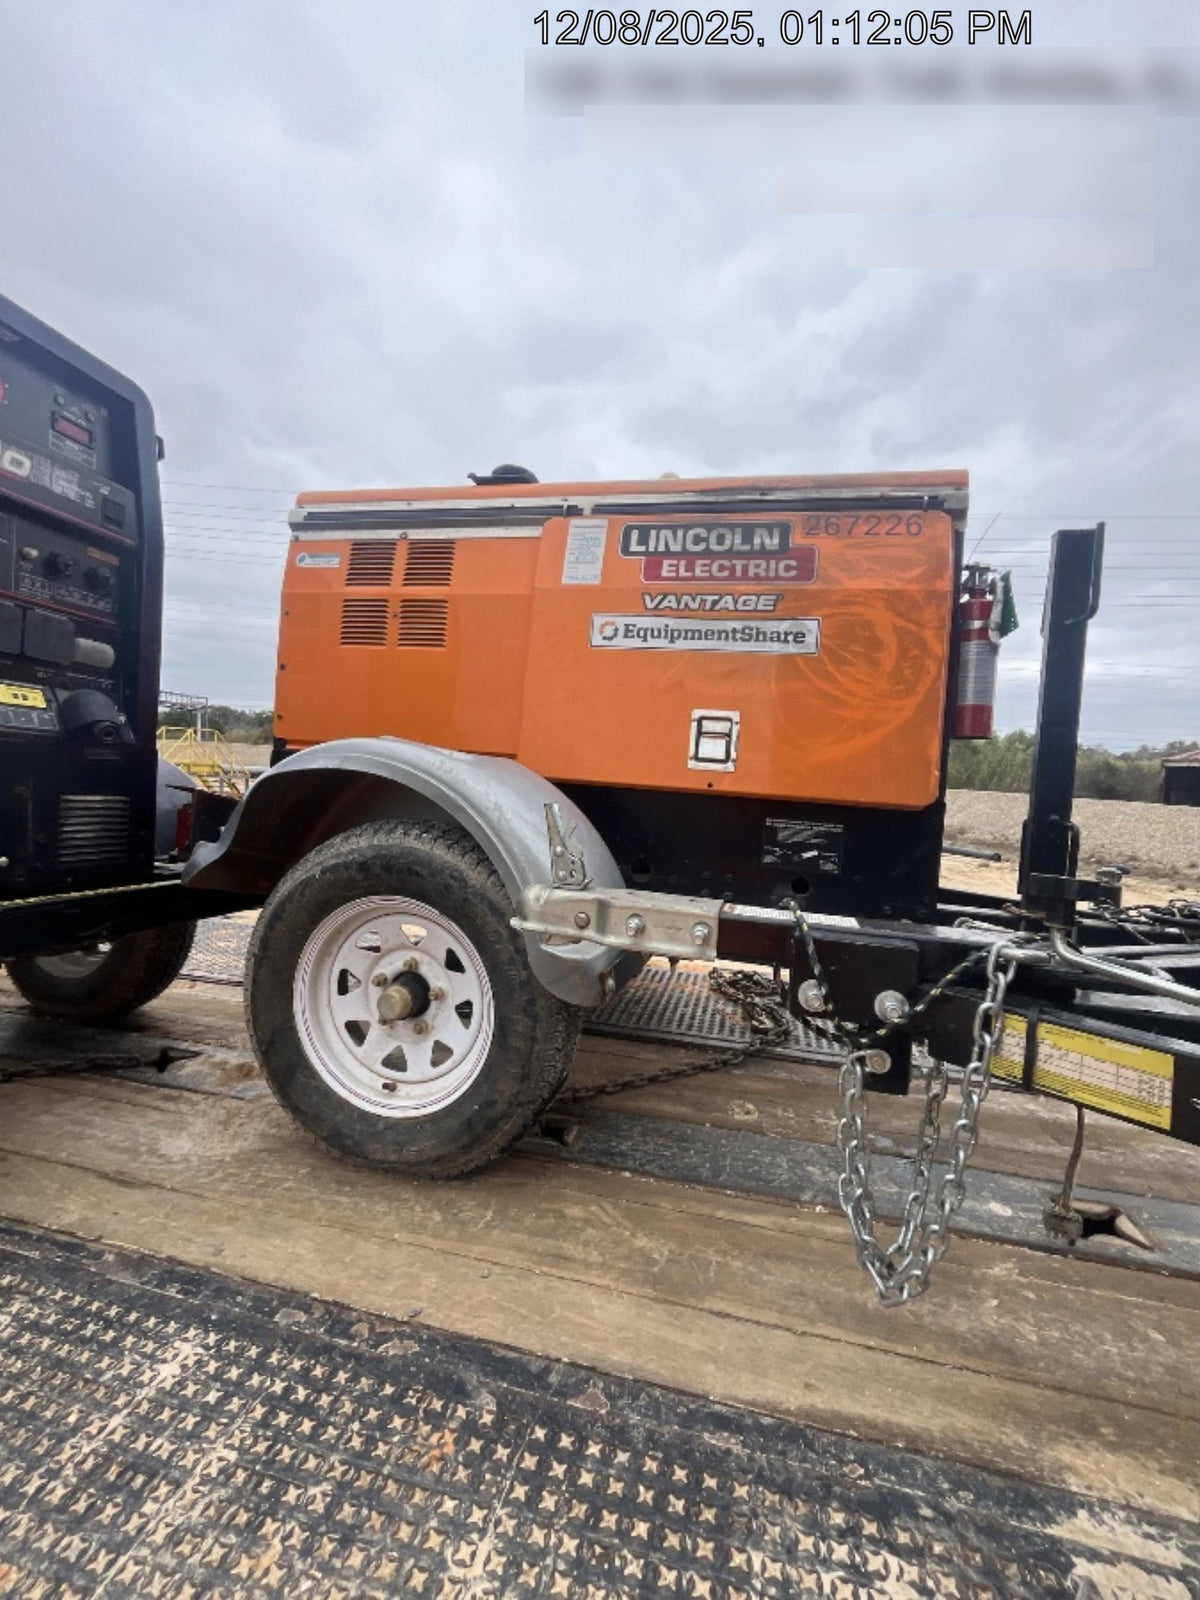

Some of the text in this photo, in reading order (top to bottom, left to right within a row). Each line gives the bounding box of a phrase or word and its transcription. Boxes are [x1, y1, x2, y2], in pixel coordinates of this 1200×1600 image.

[805, 513, 922, 536] 267226
[628, 527, 780, 552] LINCOLN
[660, 558, 799, 578] ELECTRIC
[641, 593, 780, 611] VANTAGE
[622, 622, 807, 645] EquipmentShare
